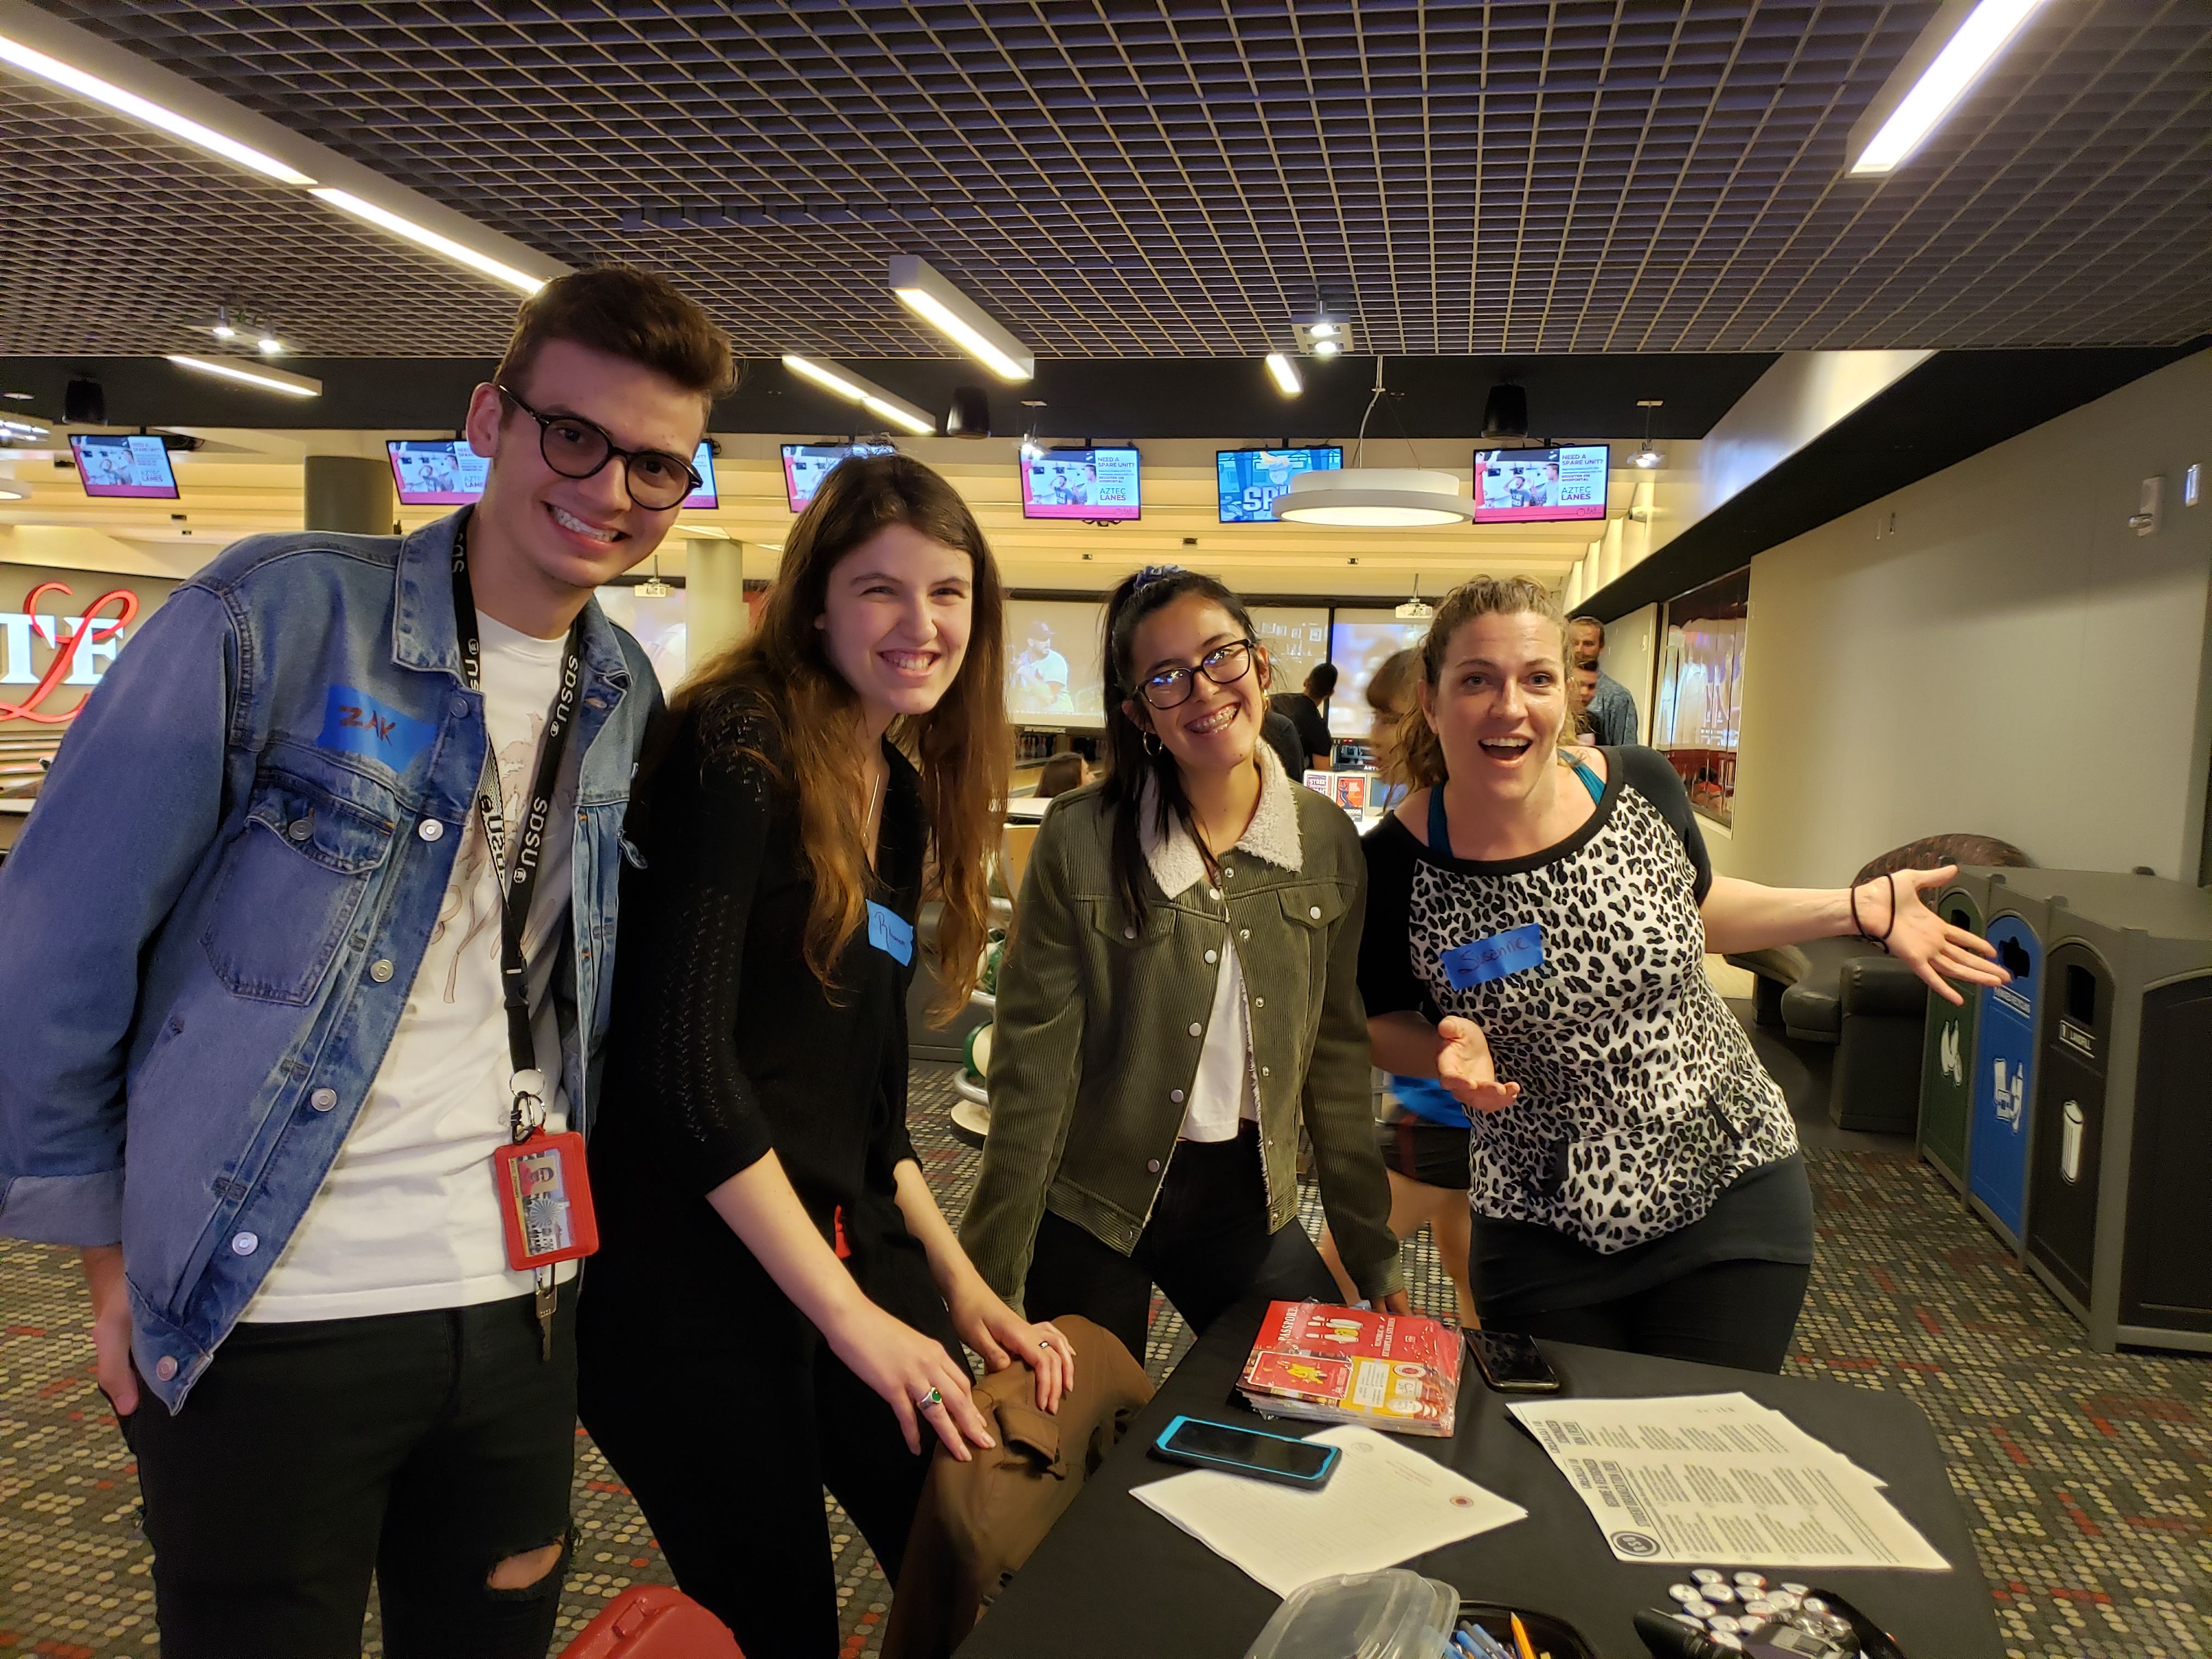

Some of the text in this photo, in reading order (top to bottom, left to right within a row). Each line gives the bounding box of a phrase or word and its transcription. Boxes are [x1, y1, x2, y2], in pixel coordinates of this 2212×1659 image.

[556, 654, 578, 723] SDSU
[339, 706, 396, 746] ZAK
[521, 796, 548, 867] SDSU
[1278, 1307, 1297, 1341] PASSPORT
[1608, 1474, 1638, 1506] ORGANIZATION
